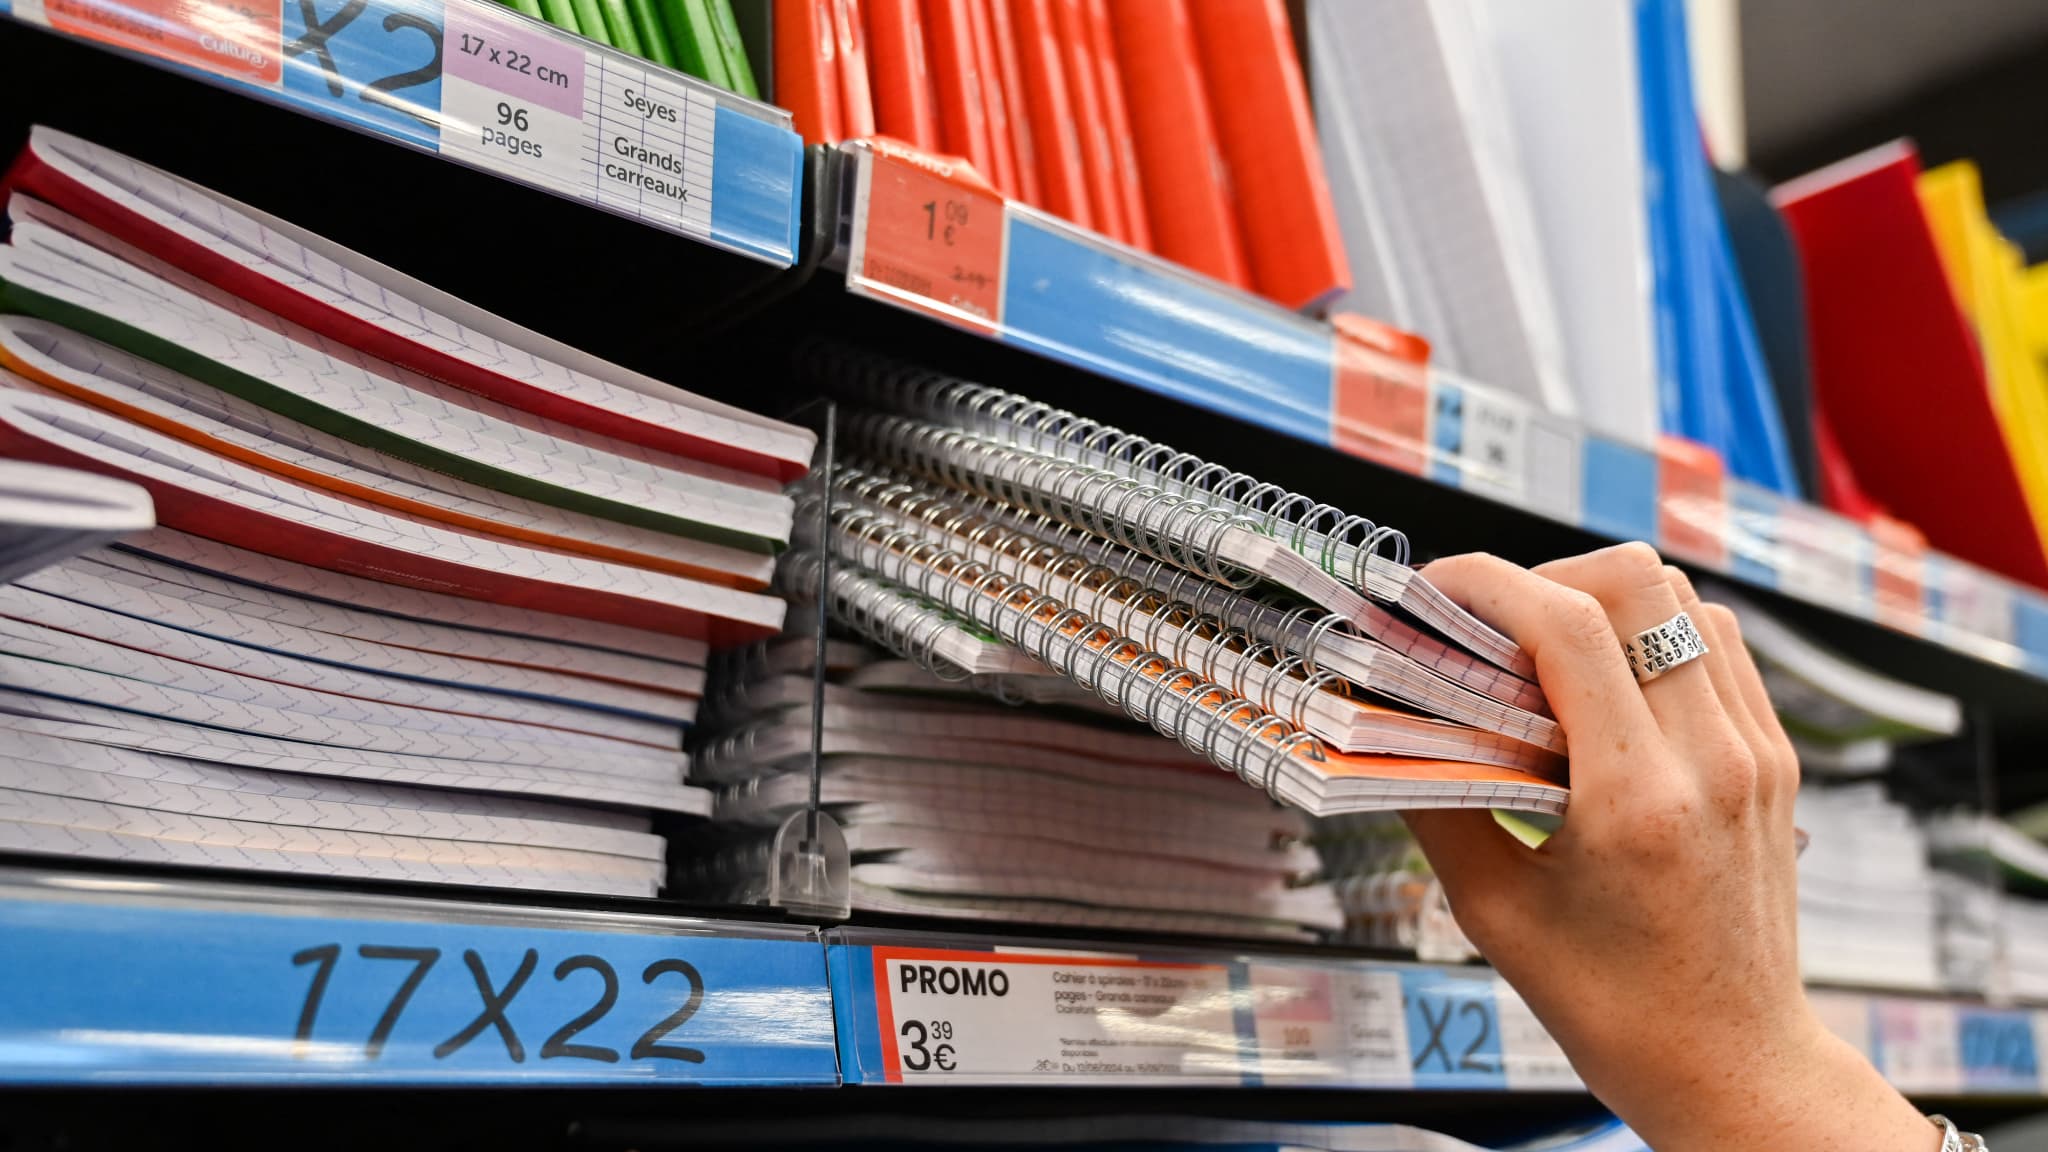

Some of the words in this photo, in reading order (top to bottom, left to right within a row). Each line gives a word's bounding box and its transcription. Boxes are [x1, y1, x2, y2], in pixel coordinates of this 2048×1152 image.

[199, 34, 268, 68] Cultura
[460, 33, 484, 56] 17
[489, 48, 501, 64] x
[506, 50, 531, 75] 22
[537, 66, 569, 89] cm
[497, 102, 529, 131] 96
[623, 88, 677, 124] Seyes
[481, 125, 543, 158] pages
[614, 136, 682, 174] Grands
[605, 163, 688, 202] carreaux
[923, 201, 936, 240] 1
[1640, 628, 1669, 646] VIE
[1644, 648, 1682, 672] VECU
[900, 964, 1009, 997] PROMO
[1055, 991, 1086, 1003] pages
[292, 943, 705, 1064] 17X22
[901, 1019, 931, 1071] 3
[930, 1020, 953, 1041] 39
[1412, 996, 1495, 1074] X2
[933, 1043, 957, 1071] €
